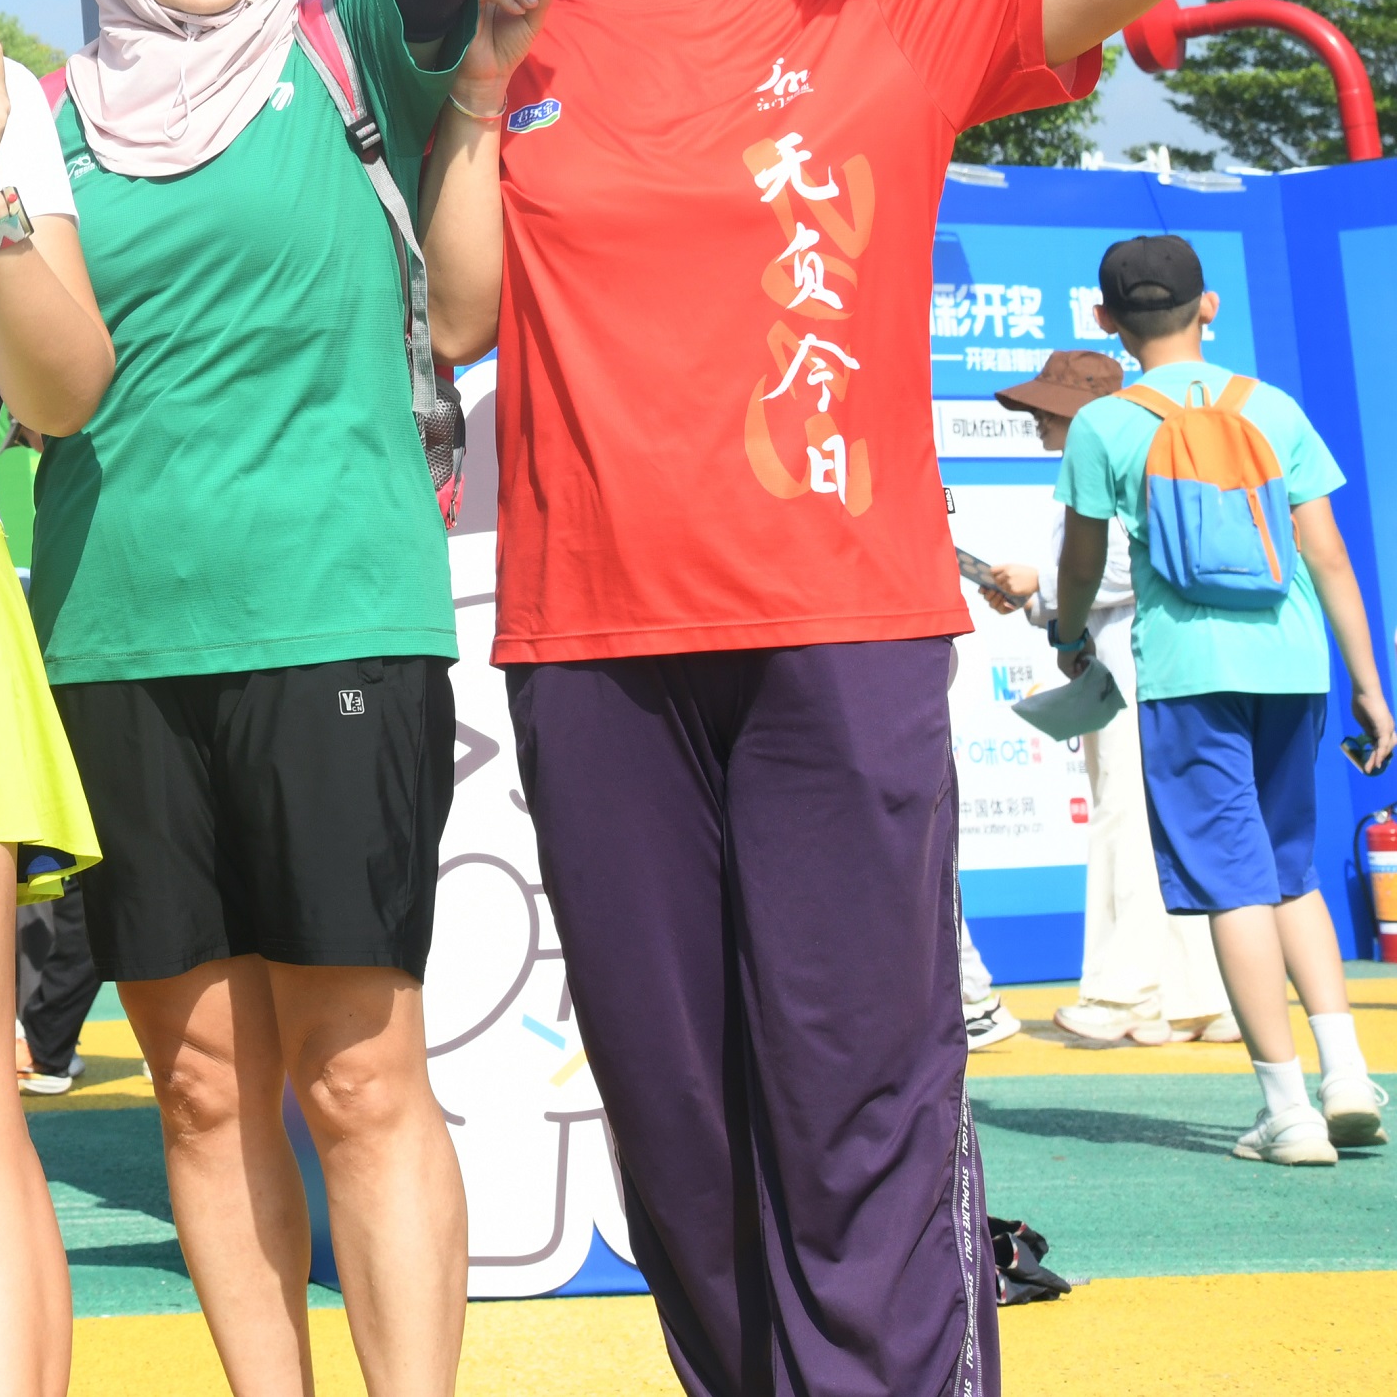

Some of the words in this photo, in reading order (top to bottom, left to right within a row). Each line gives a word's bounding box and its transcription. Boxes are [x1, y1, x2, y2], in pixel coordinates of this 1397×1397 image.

[517, 101, 554, 123] 君乐宝
[930, 283, 1045, 340] 彩开奖
[968, 738, 1030, 765] 咪咕
[959, 797, 1036, 819] 中国体彩网
[964, 1231, 973, 1263] LOLI
